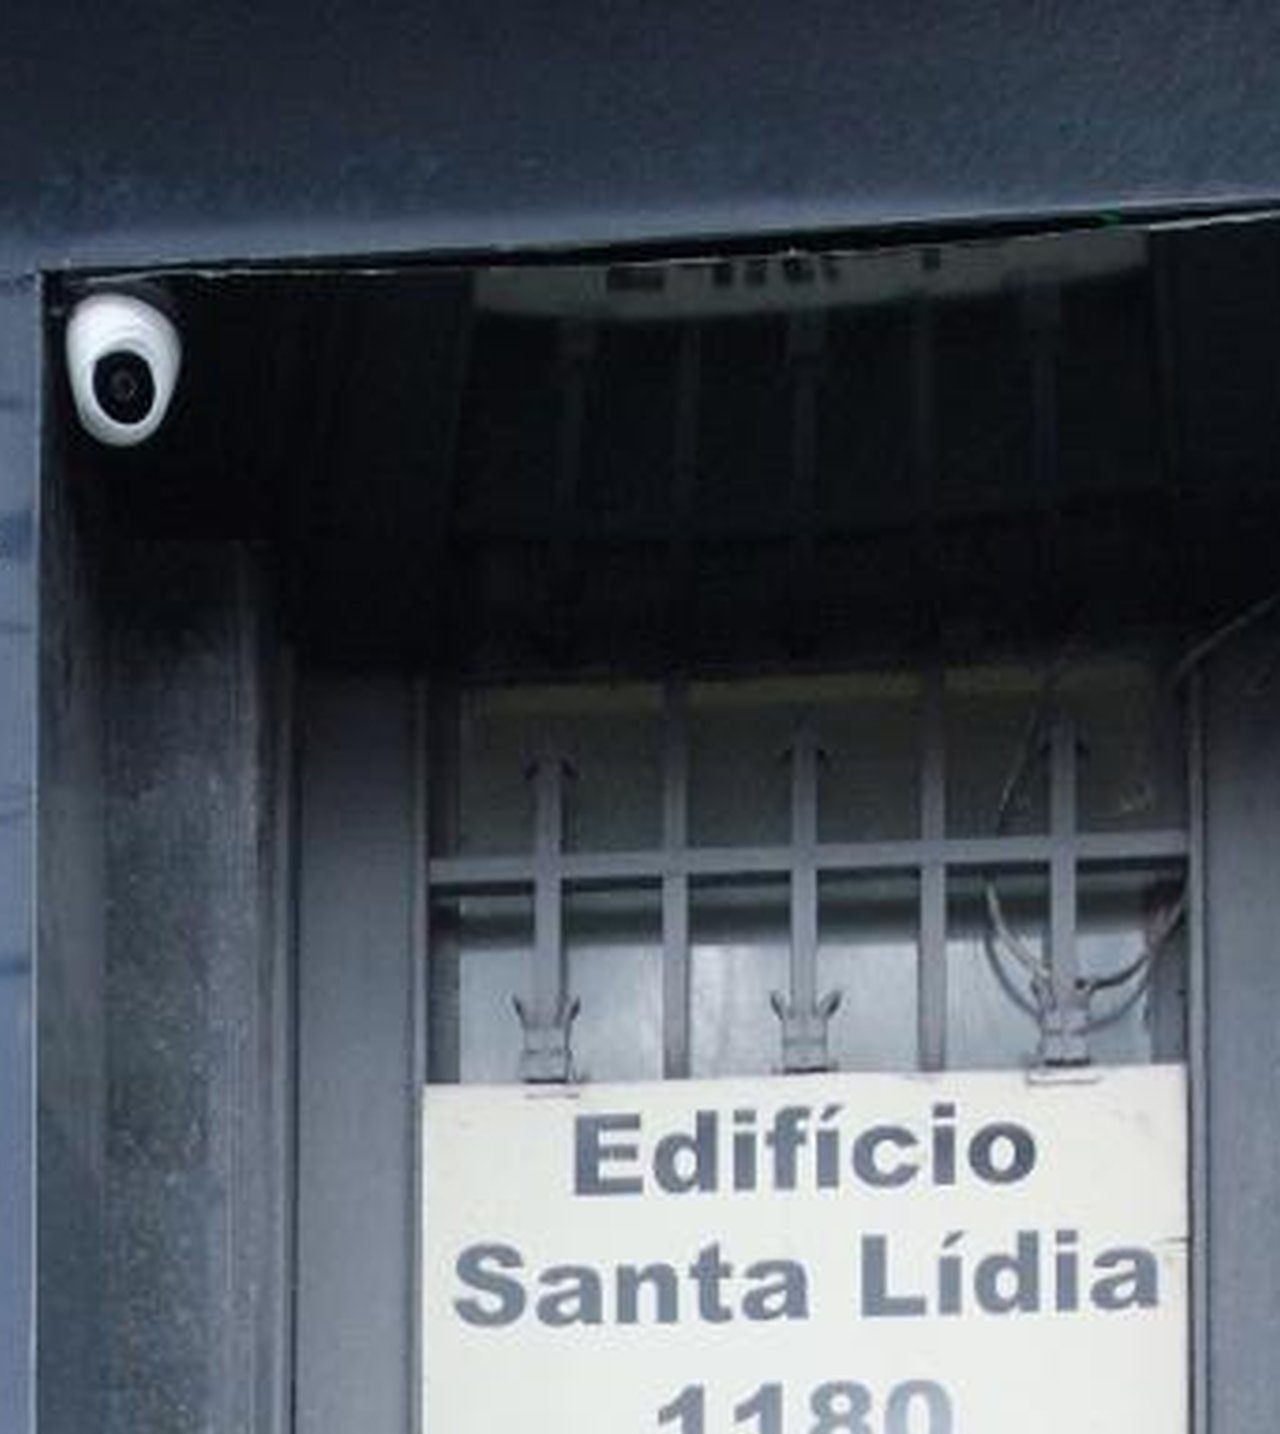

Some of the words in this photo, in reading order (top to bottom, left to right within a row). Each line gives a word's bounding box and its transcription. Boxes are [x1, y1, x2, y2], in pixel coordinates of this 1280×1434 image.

[572, 1102, 1039, 1197] Edifício
[451, 1241, 811, 1329] Santa
[859, 1229, 1160, 1318] Lídia
